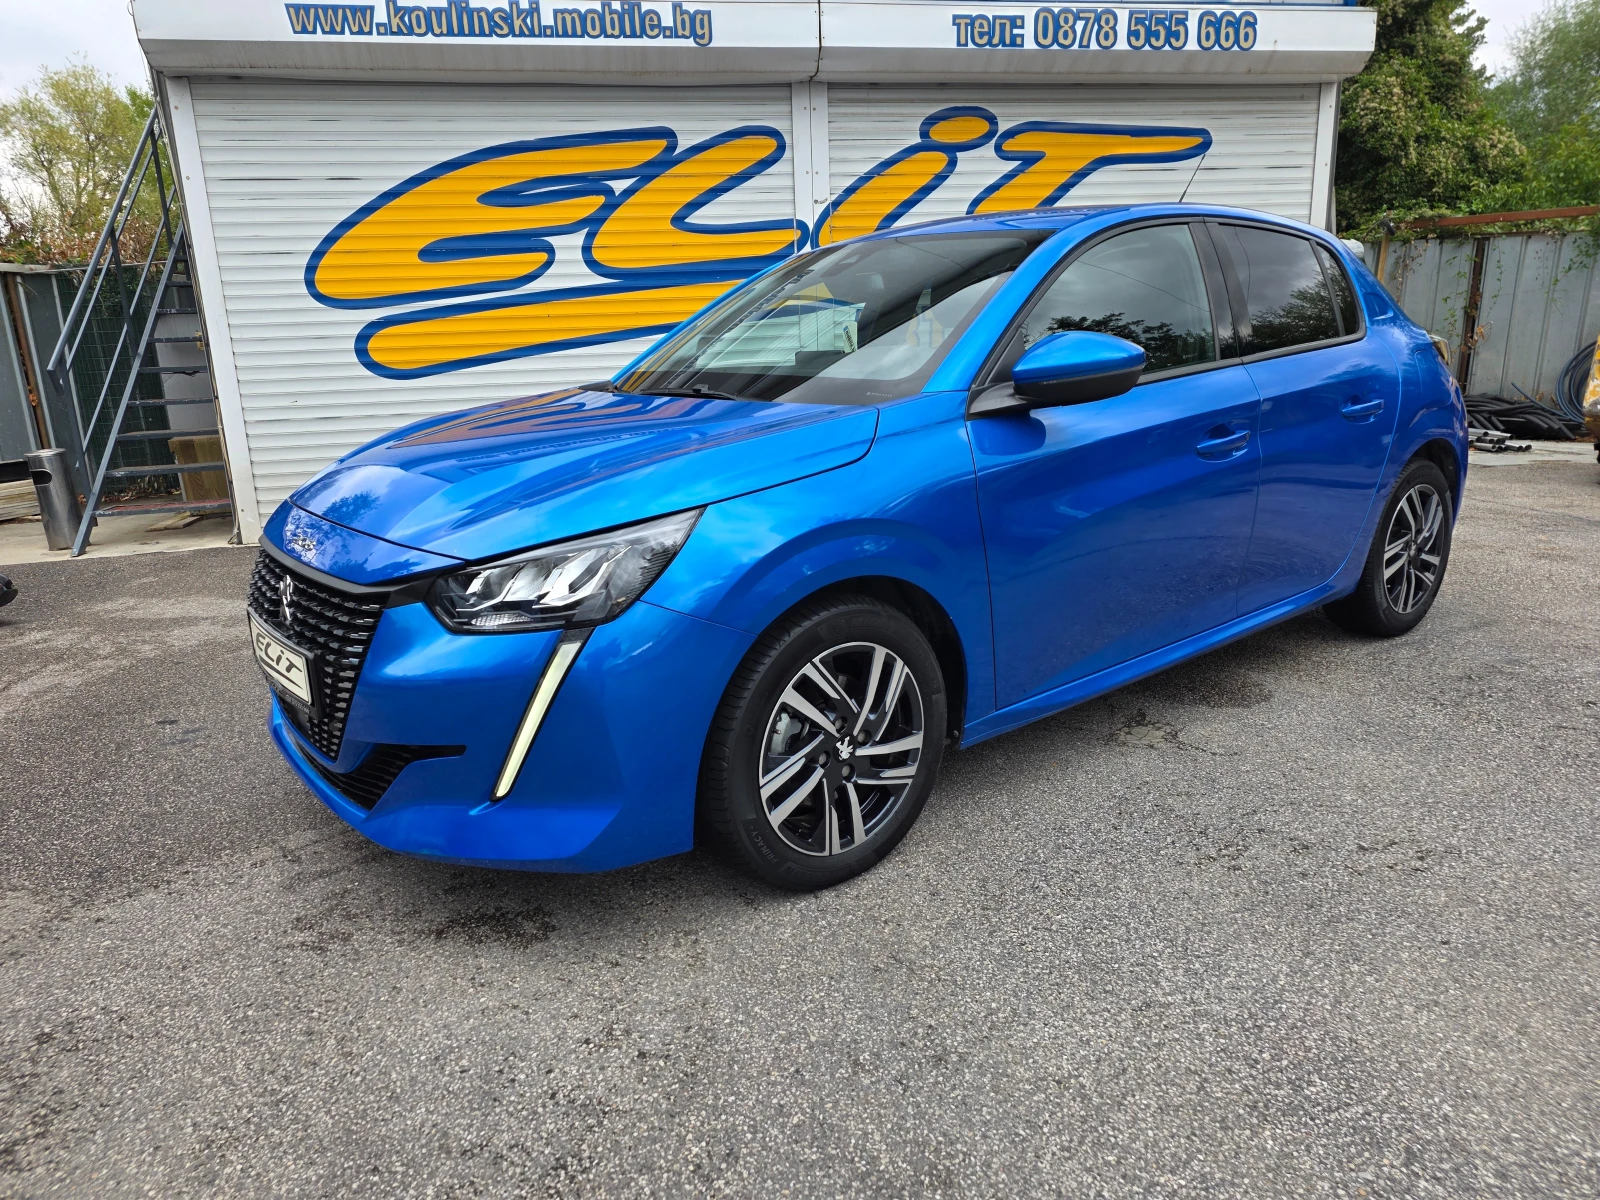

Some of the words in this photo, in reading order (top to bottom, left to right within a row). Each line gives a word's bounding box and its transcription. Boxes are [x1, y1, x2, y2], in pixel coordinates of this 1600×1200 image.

[284, 0, 713, 47] www.koulinski.mobile.bg
[952, 13, 1025, 48] тел:
[1034, 7, 1118, 50] 0878
[1127, 10, 1190, 50] 555
[1197, 10, 1258, 51] 666
[750, 830, 779, 864] PRIMACY
